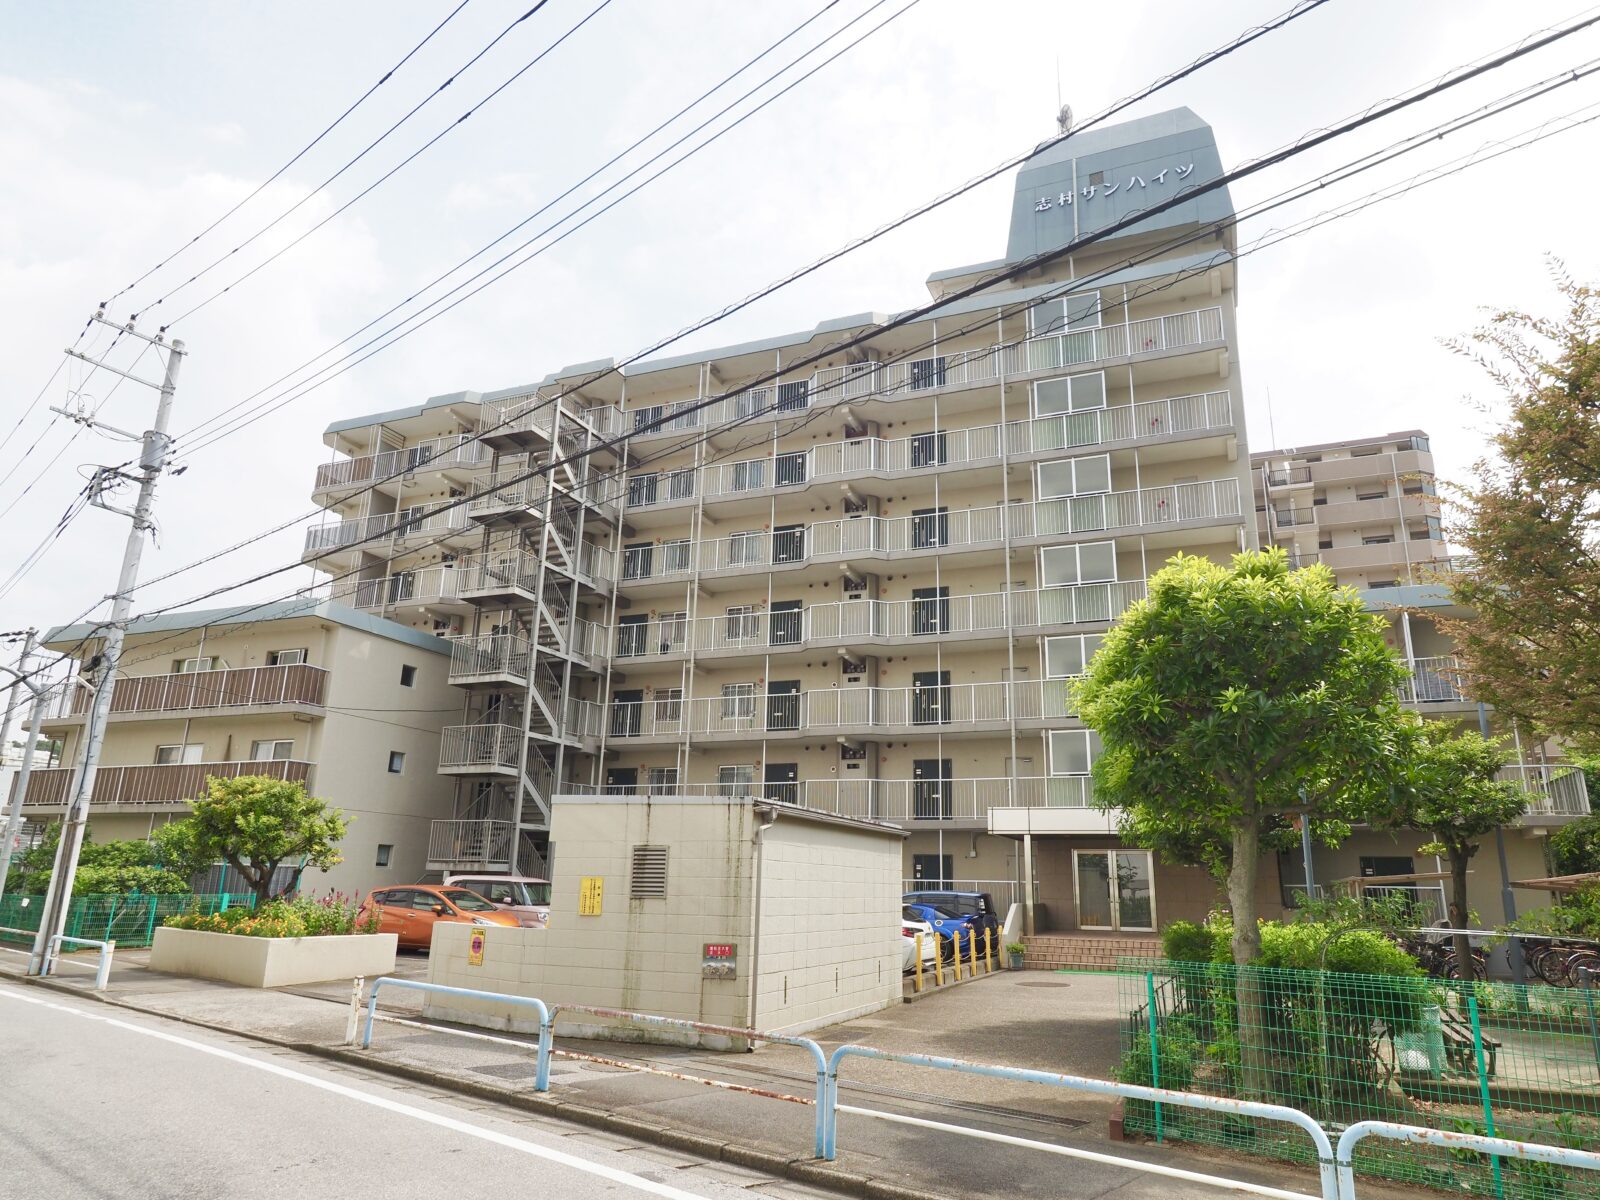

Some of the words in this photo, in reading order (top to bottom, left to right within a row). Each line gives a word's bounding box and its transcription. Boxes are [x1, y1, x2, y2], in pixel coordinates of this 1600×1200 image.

[1035, 163, 1194, 212] 志村サンハイツ
